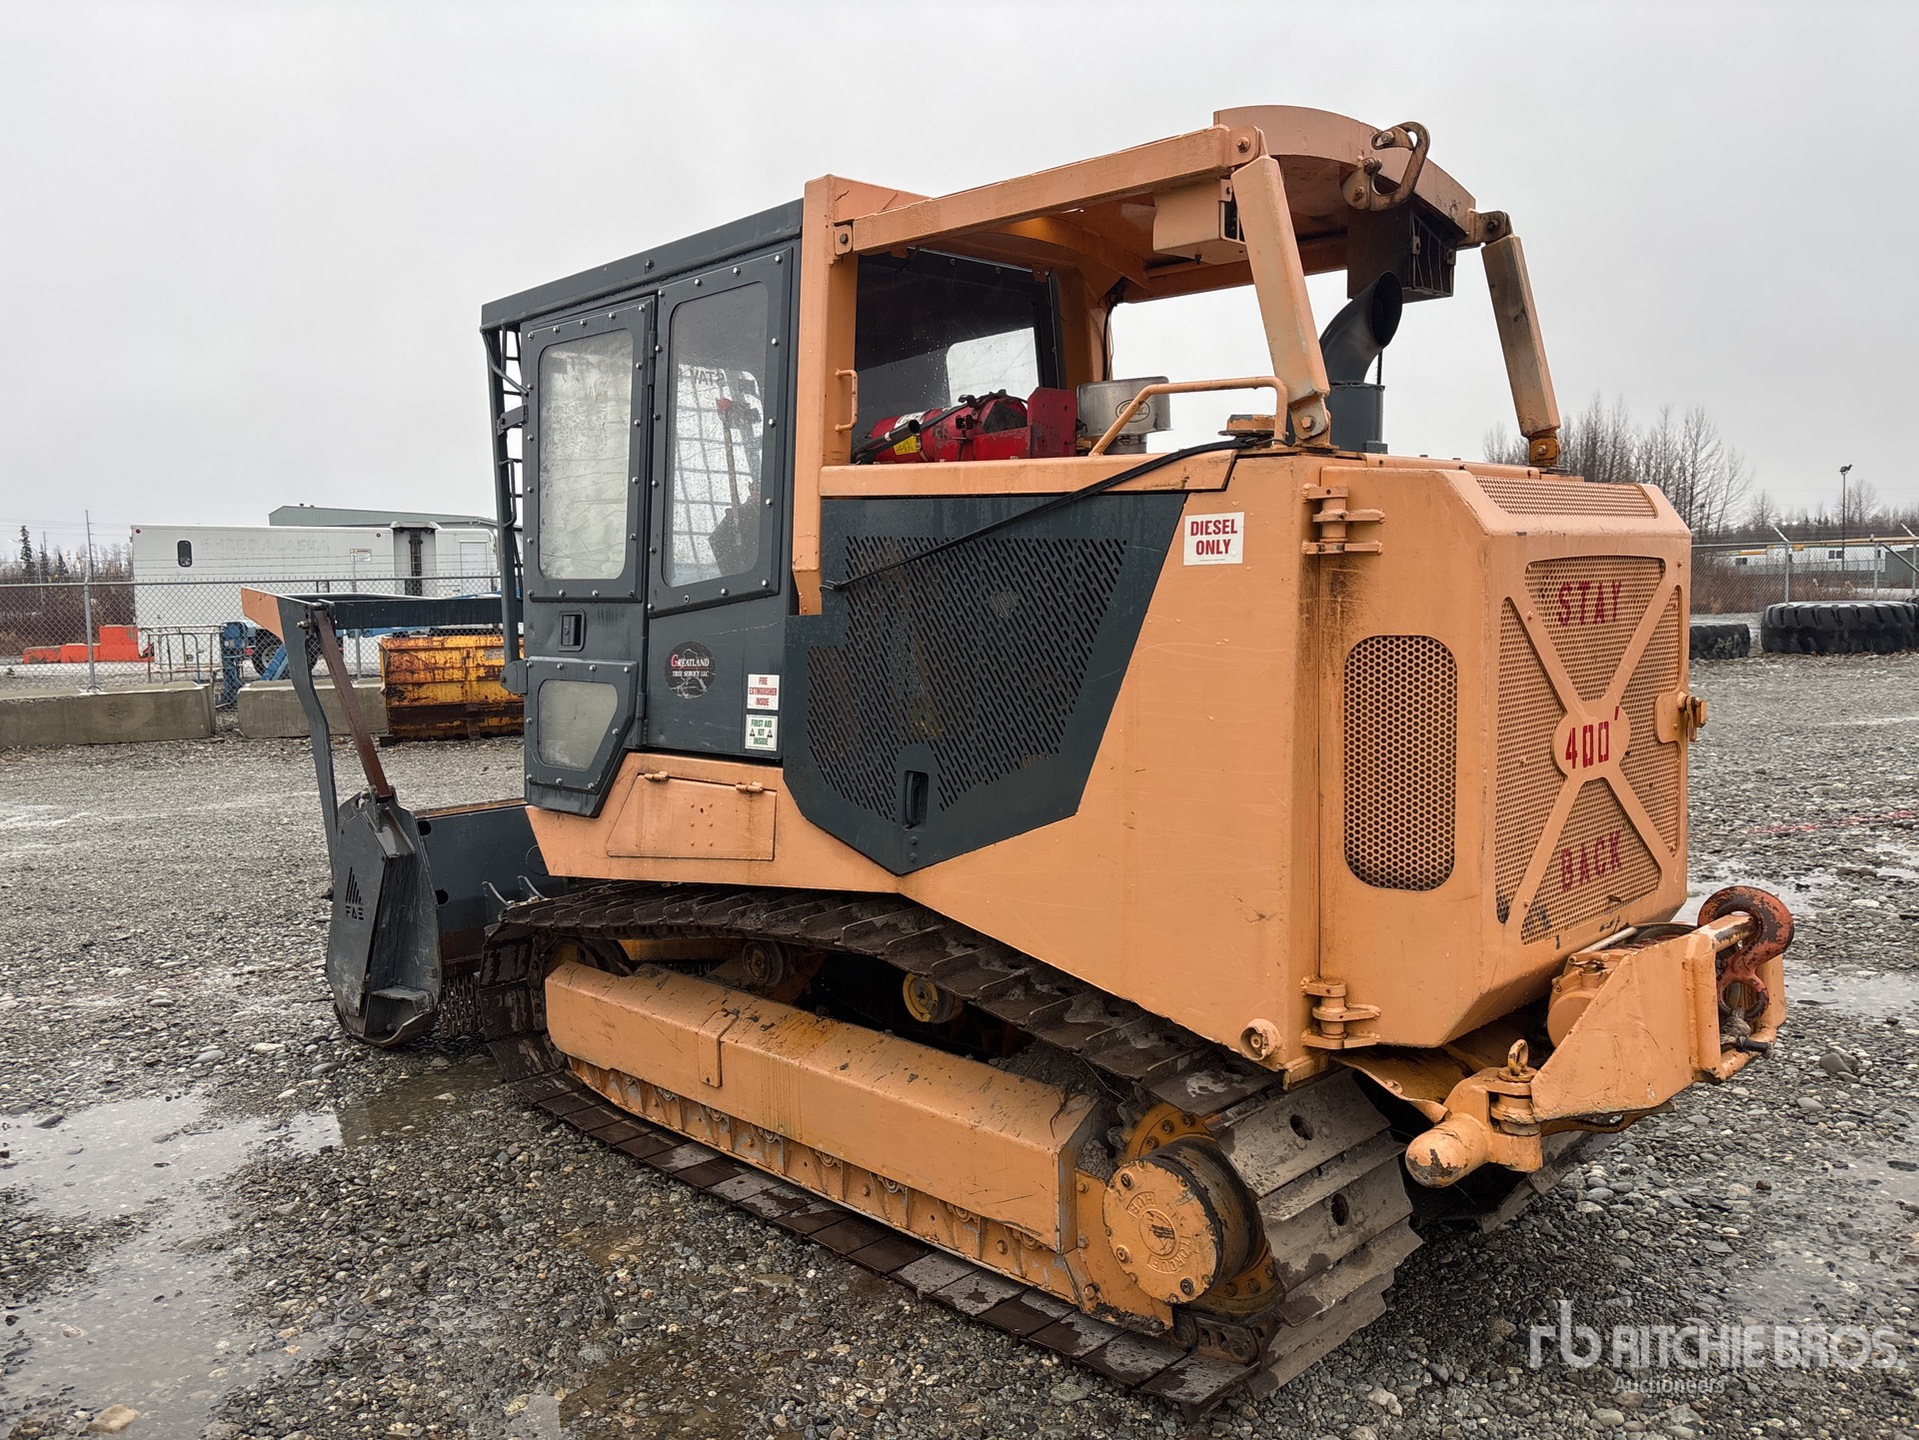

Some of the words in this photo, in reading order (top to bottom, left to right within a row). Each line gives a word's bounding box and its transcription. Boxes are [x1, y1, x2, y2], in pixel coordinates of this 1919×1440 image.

[1190, 518, 1238, 536] DIESEL
[1196, 539, 1231, 556] ONLY
[1556, 580, 1621, 626] STAY
[758, 676, 768, 685] FIRE
[756, 698, 769, 706] INSIDE
[751, 719, 763, 727] FIRST
[764, 720, 772, 728] AID
[757, 728, 765, 736] KIT
[753, 737, 768, 745] INSIDE
[1560, 829, 1621, 891] BACK
[1130, 1194, 1155, 1215] HUB
